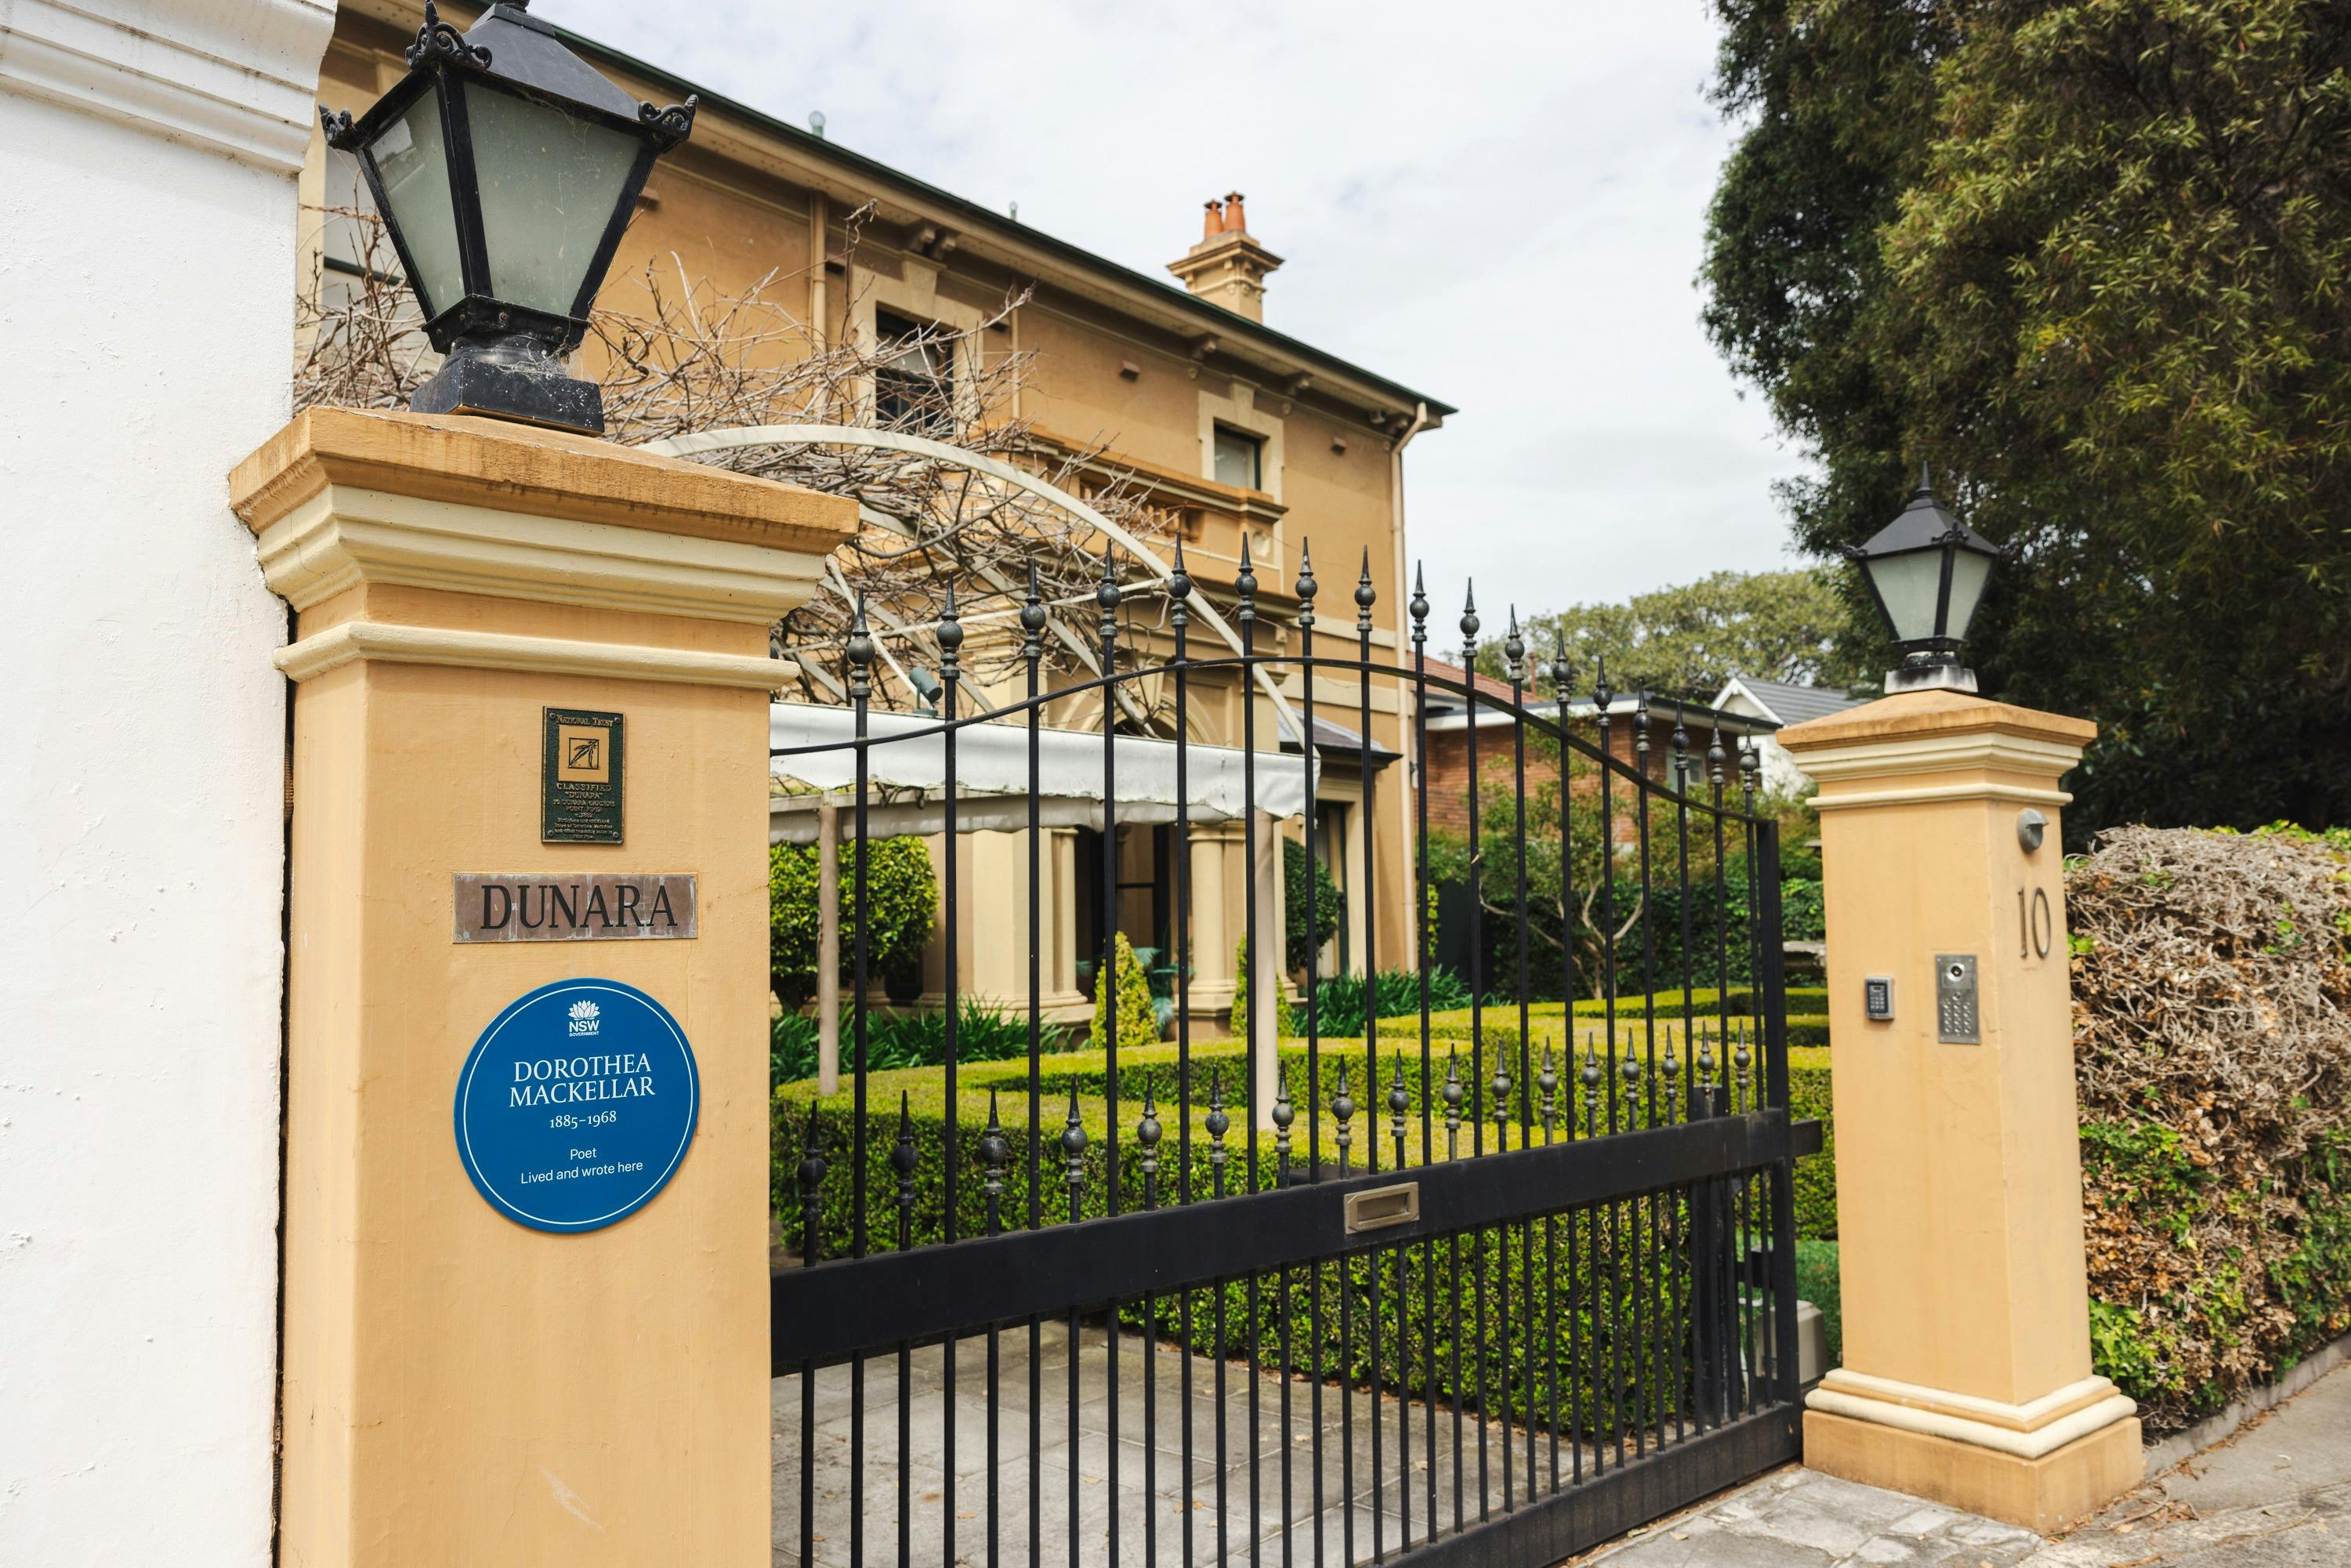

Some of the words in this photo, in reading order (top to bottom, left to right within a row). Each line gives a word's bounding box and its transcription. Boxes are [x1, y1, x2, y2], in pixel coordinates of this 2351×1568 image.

[556, 783, 611, 791] CLASSIFIED
[480, 885, 679, 929] DUNARA
[2018, 885, 2051, 958] 10
[569, 1020, 600, 1032] NSW
[513, 1052, 652, 1082] DOROTHEA
[509, 1076, 655, 1107] MACKELLAR
[549, 1110, 617, 1129] 1885–1968
[570, 1147, 597, 1161] Poet
[520, 1169, 553, 1184] Lived
[556, 1166, 578, 1181] and
[581, 1163, 614, 1177] wrote
[618, 1161, 643, 1173] here
